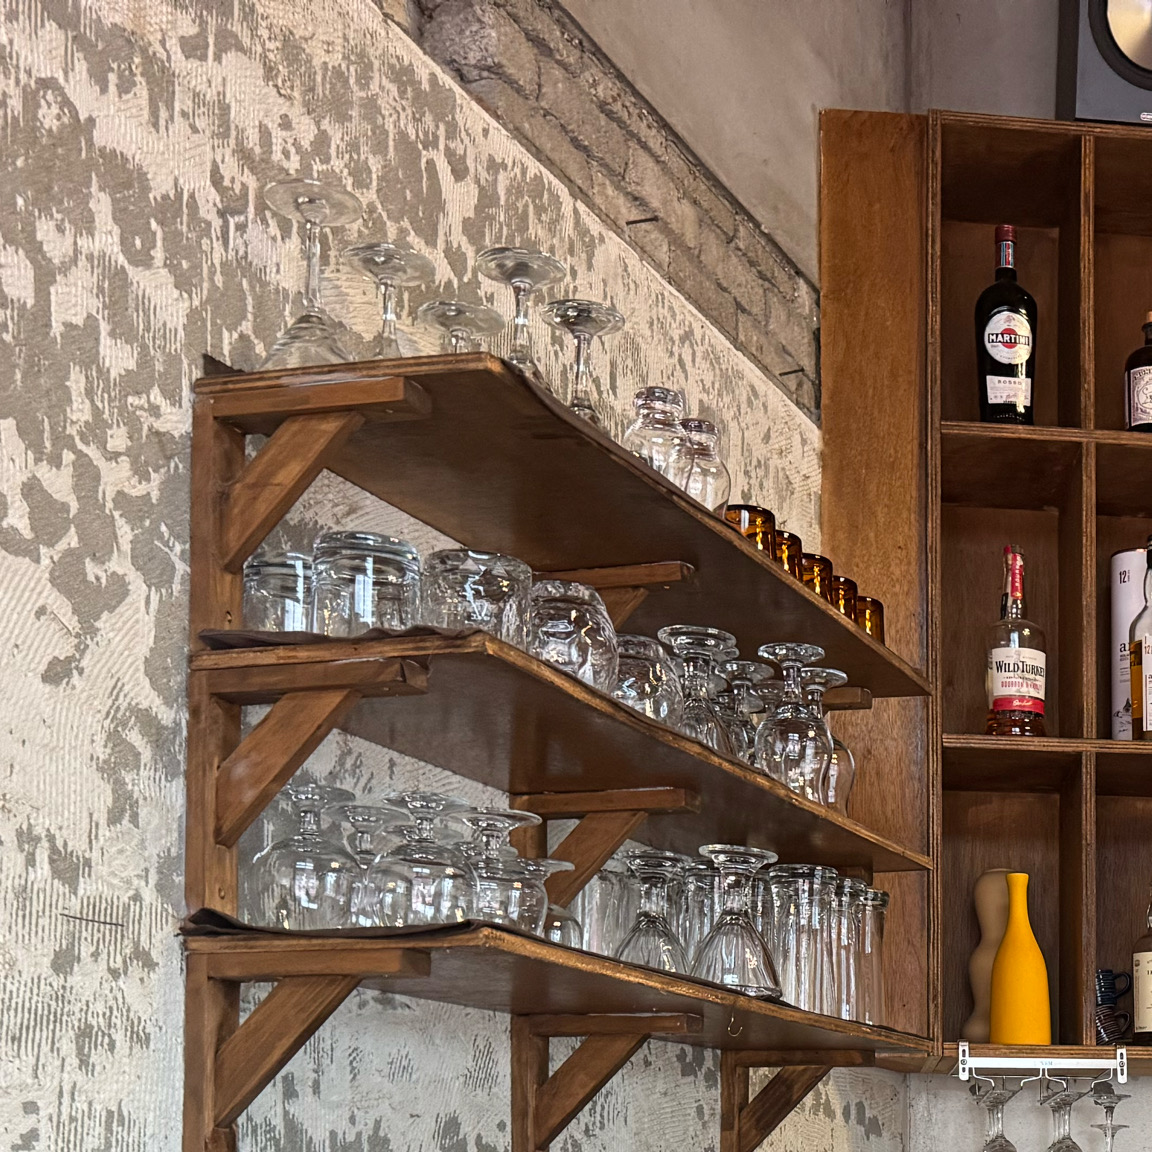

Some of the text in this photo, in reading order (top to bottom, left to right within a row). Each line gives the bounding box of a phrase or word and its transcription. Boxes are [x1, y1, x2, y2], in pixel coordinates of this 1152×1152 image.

[989, 334, 1029, 345] MARTINI
[1119, 570, 1127, 584] 12
[1144, 645, 1151, 655] 12
[995, 660, 1020, 673] WILD
